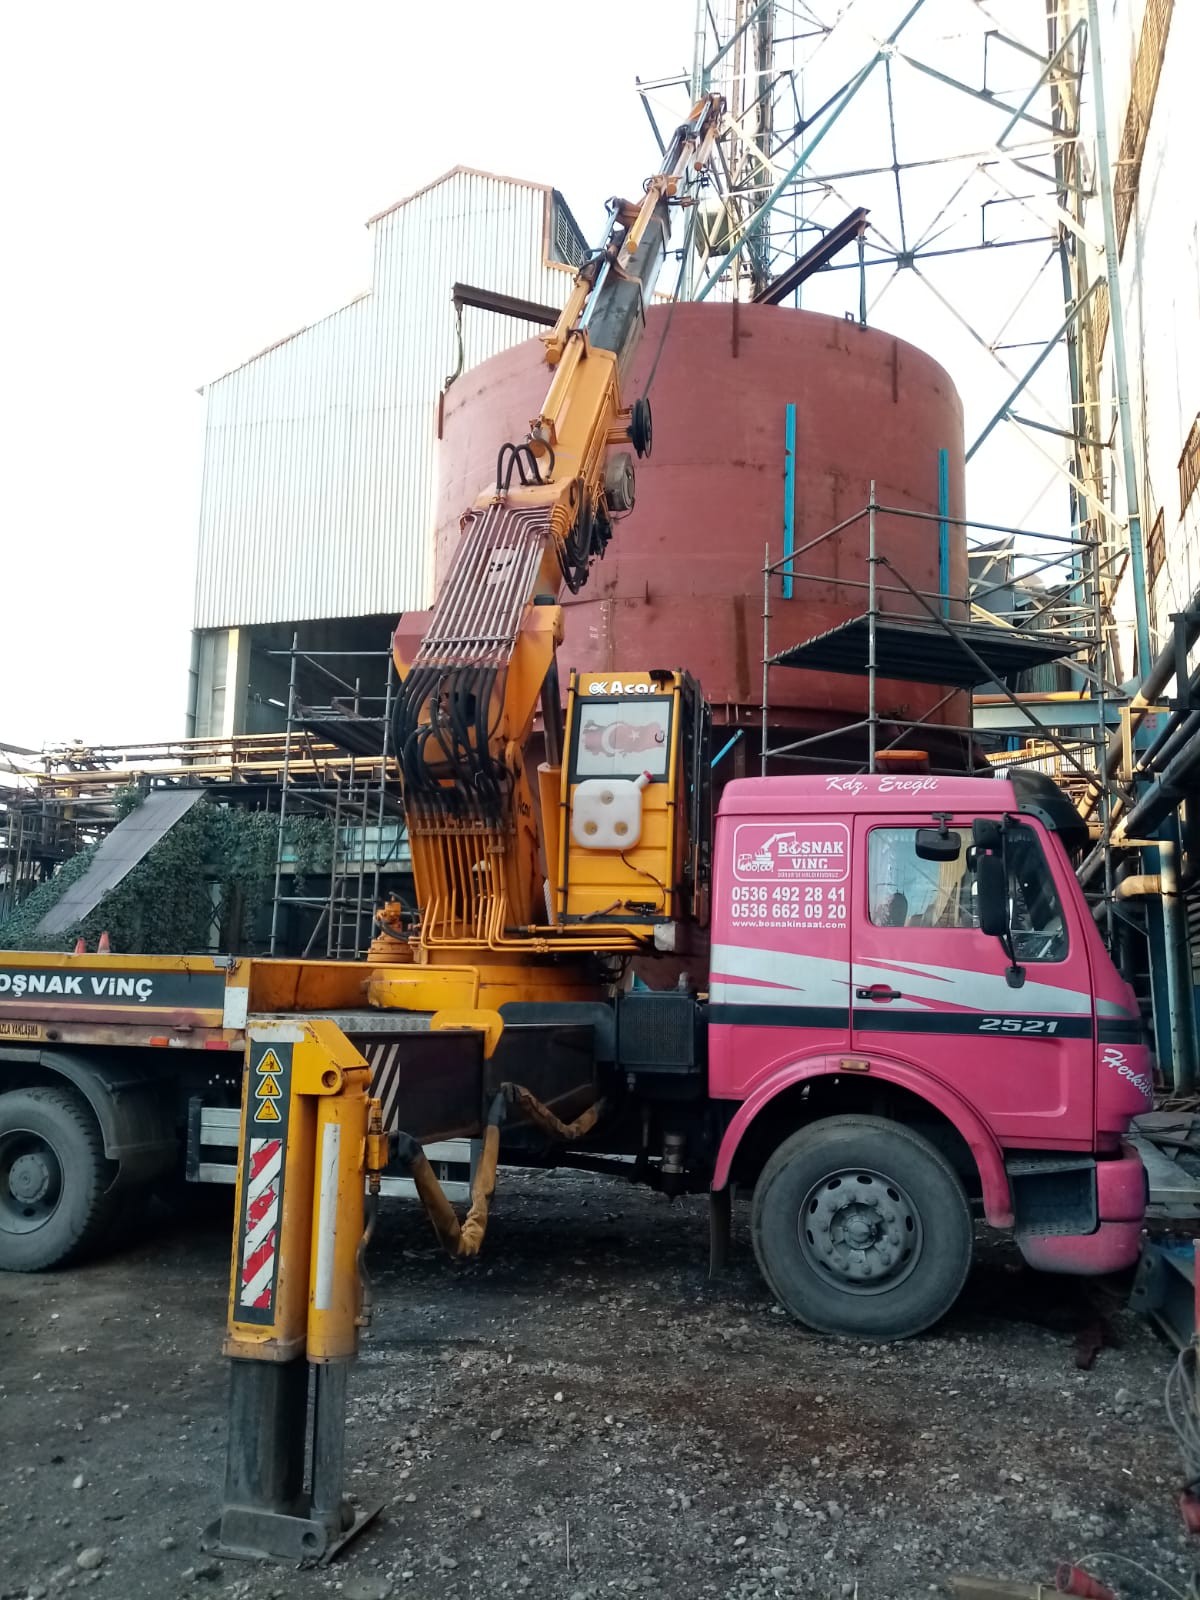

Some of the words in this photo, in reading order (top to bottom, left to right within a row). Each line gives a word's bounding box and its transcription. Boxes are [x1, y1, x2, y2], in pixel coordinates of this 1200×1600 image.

[610, 681, 658, 694] Acar
[825, 776, 868, 796] Kdz.
[878, 776, 939, 796] Ereğli
[732, 886, 768, 901] 0536
[772, 887, 800, 901] 492
[804, 887, 823, 902] 28
[828, 887, 845, 902] 41
[731, 903, 767, 918] 0536
[772, 904, 800, 918] 662
[804, 904, 823, 919] 09
[828, 905, 847, 919] 20
[732, 920, 847, 929] www.bosnakinsaat.com
[0, 974, 83, 997] OŞNAK
[979, 1018, 1058, 1033] 2521
